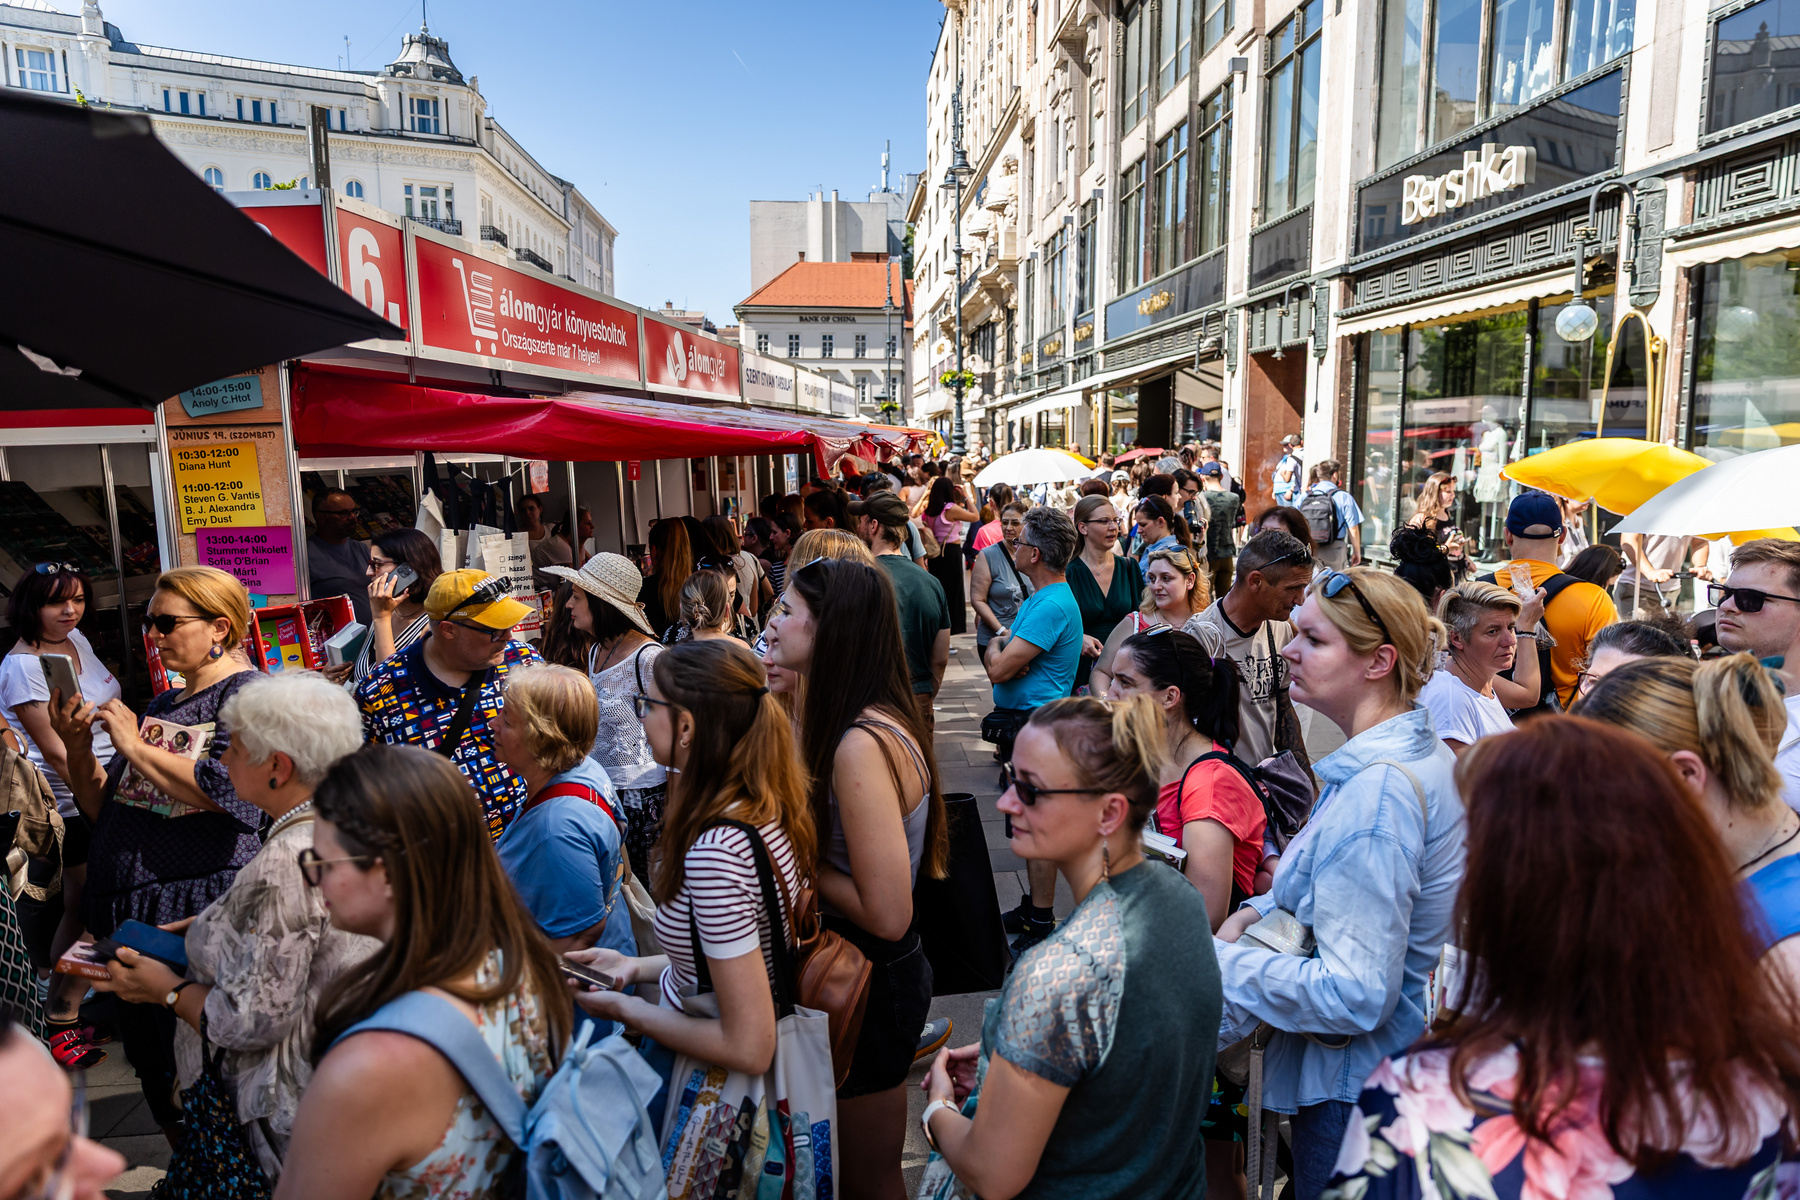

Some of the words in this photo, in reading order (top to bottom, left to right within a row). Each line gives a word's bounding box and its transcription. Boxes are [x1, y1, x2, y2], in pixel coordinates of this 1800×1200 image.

[1401, 143, 1528, 225] Bershka
[348, 227, 400, 330] 6.
[500, 288, 562, 333] álomgyár
[565, 310, 627, 347] könyvesboltok
[502, 327, 556, 356] Országszerte
[557, 341, 570, 359] már
[572, 343, 577, 359] 7
[577, 345, 600, 366] helyen!
[688, 344, 725, 382] álomgyár
[746, 368, 760, 385] SZENT
[190, 381, 251, 397] 14:00-15:00
[192, 398, 218, 409] Anoly
[221, 393, 251, 405] C.Htot
[172, 429, 210, 441] JÚNIUS
[230, 431, 276, 439] (SZOMBAT)
[178, 448, 239, 460] 10:30-12:00
[179, 461, 206, 471] Diana
[208, 460, 231, 469] Hunt
[182, 481, 243, 492] 11:00-12:00
[184, 495, 215, 504] Steven
[218, 493, 228, 502] G.
[231, 491, 260, 501] Vantis
[185, 506, 196, 515] B.
[198, 505, 206, 514] J.
[209, 503, 256, 513] Alexandra
[187, 517, 207, 526] Emy
[210, 515, 232, 524] Dust
[206, 535, 267, 544] 13:00-14:00
[206, 546, 249, 555] Stummer
[252, 545, 288, 554] Nikolett
[208, 557, 232, 566] Sofia
[234, 557, 269, 565] O'Brian
[507, 554, 526, 562] szingli
[233, 567, 257, 576] Márti
[240, 578, 262, 587] Gina
